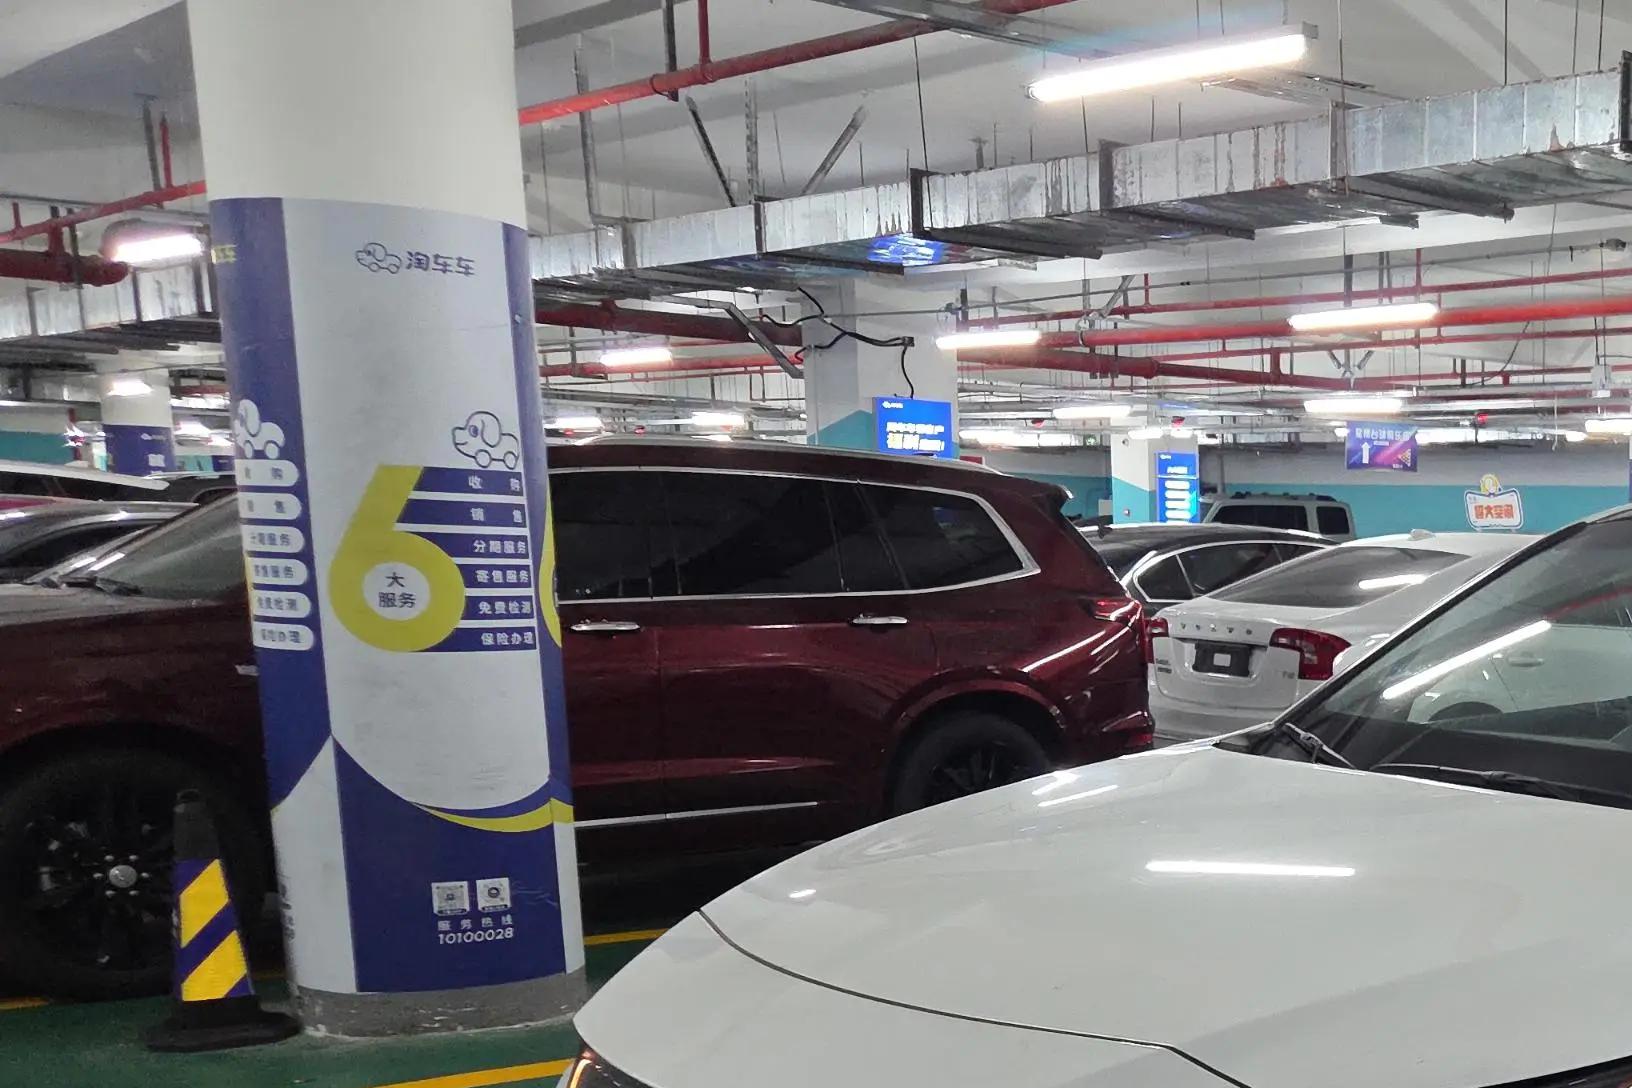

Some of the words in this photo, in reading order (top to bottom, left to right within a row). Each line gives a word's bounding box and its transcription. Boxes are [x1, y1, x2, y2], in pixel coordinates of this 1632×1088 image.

[405, 250, 475, 276] 淘车车
[473, 540, 526, 554] 分期服务
[329, 465, 466, 652] 6
[386, 572, 406, 587] 大
[378, 592, 416, 608] 服务
[478, 600, 531, 614] 免费检测
[480, 631, 534, 646] 保险办理
[438, 927, 514, 945] 10100028
